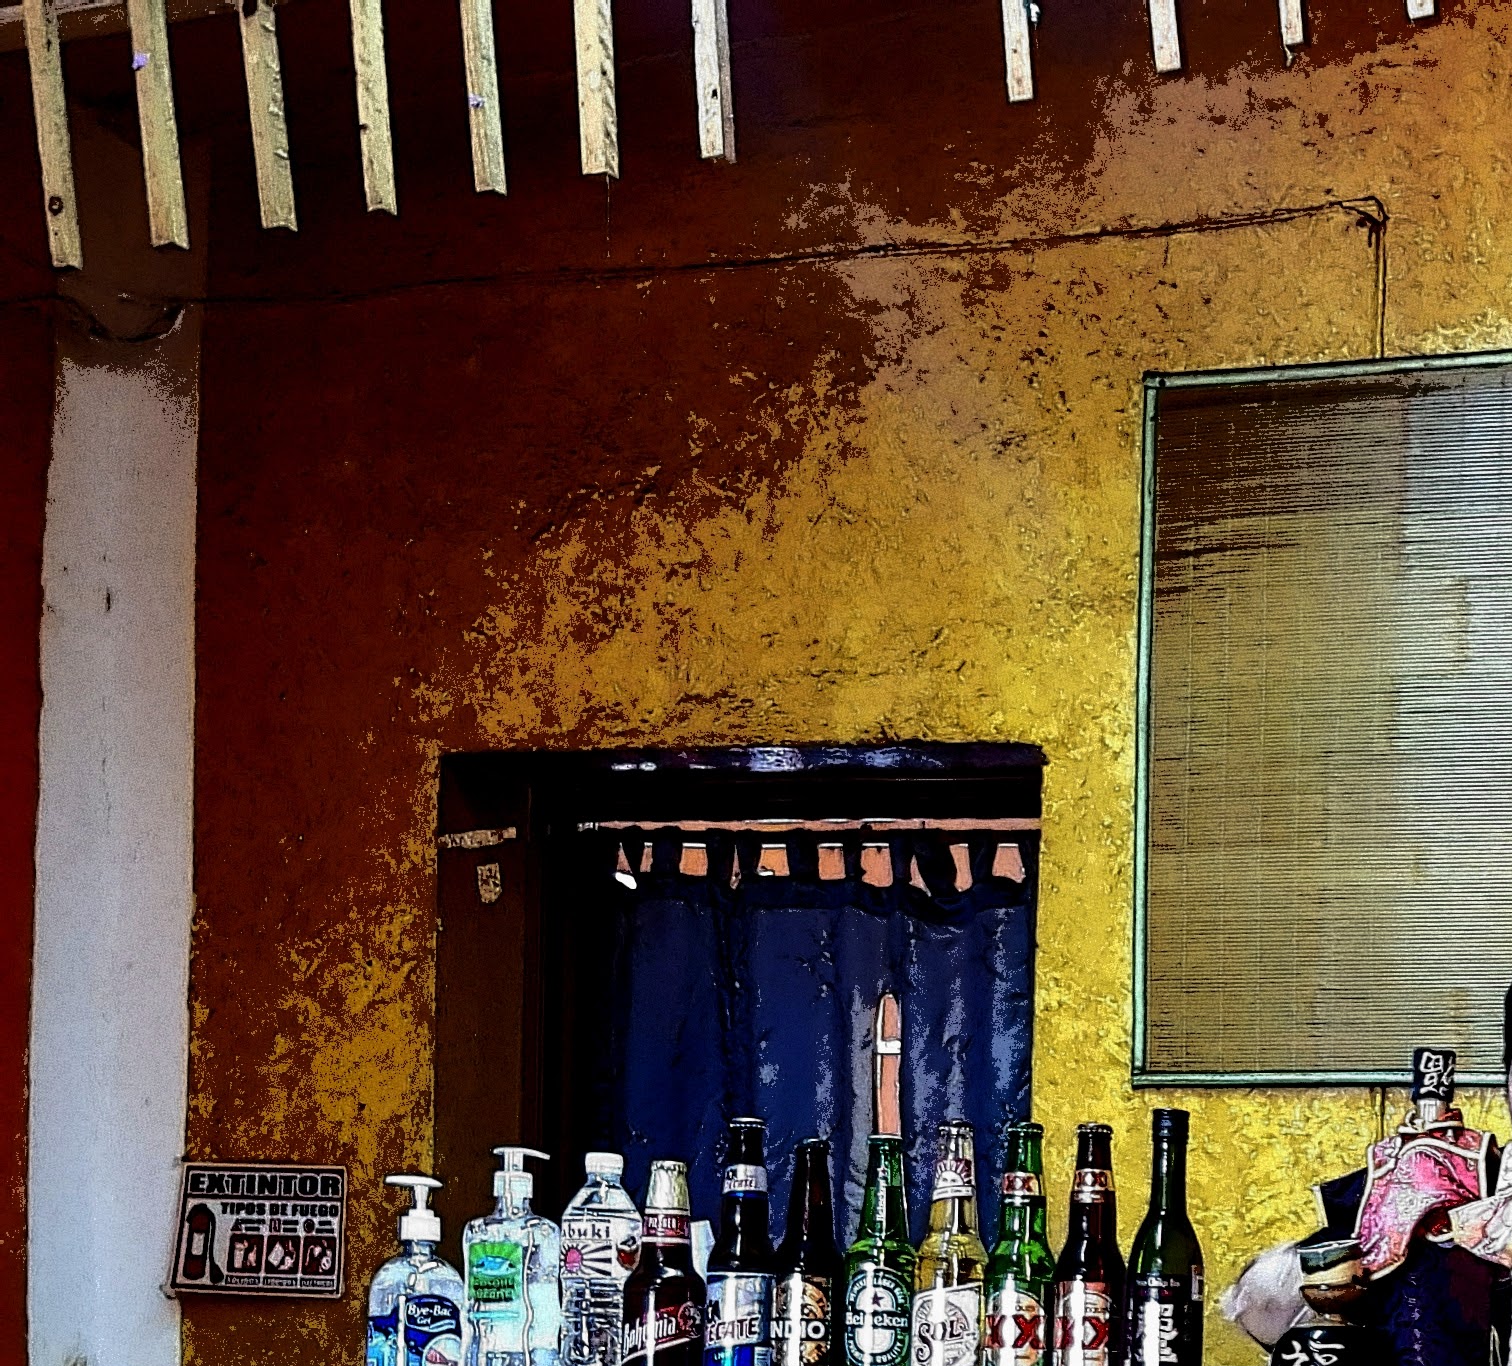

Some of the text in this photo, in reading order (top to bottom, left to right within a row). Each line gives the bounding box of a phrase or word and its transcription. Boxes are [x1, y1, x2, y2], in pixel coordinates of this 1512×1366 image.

[187, 1171, 342, 1197] EXTINTOR
[221, 1202, 339, 1217] TIPOS DE FUEGO
[407, 1303, 453, 1320] Bye-Bac
[845, 1311, 908, 1327] Heieken
[706, 1316, 760, 1341] ECATE
[770, 1320, 826, 1340] NDIO
